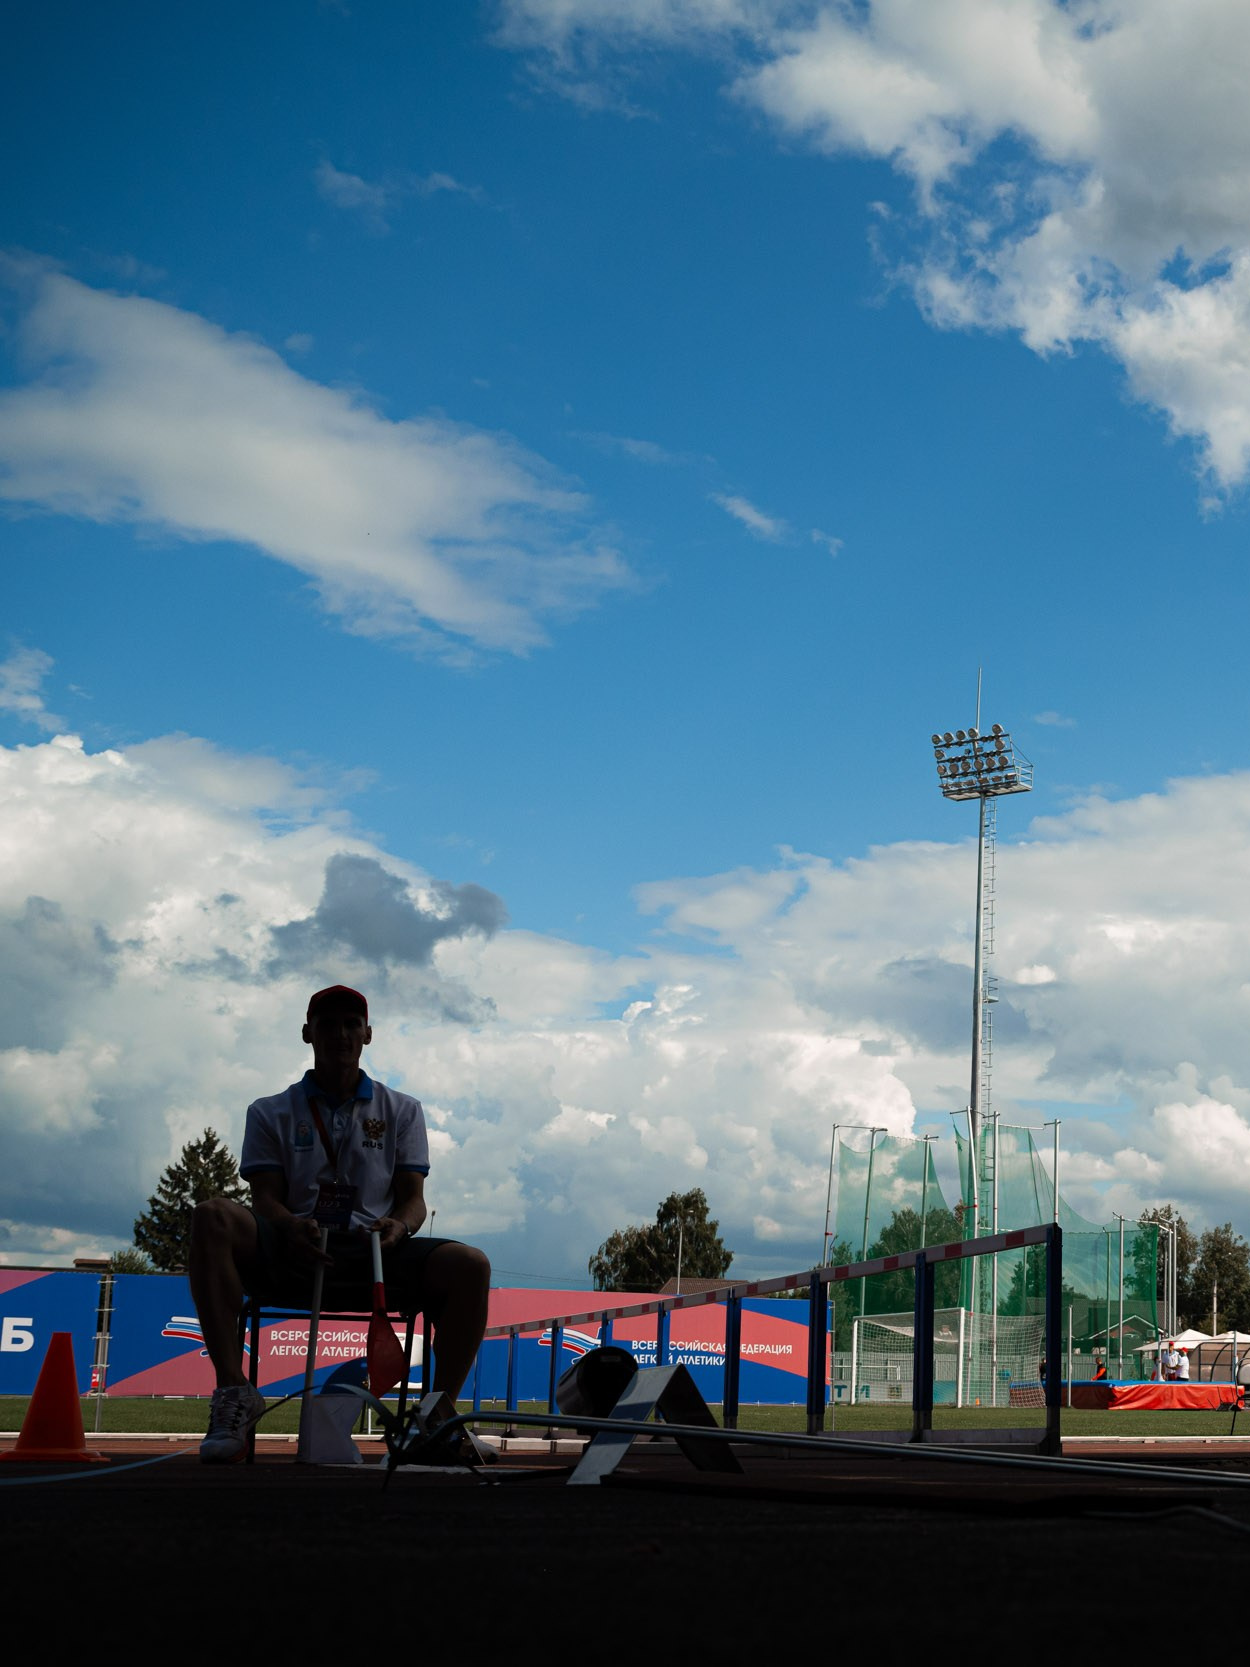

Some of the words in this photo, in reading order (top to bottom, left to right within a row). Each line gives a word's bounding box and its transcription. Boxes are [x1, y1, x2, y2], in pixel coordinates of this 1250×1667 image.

[362, 1140, 384, 1150] RUS
[0, 1316, 34, 1353] Б
[270, 1345, 318, 1356] ЛЕГКО
[631, 1339, 726, 1352] ВСЕРССИЙСКА
[741, 1343, 793, 1355] ЕДЕРАЦИЯ
[633, 1353, 673, 1364] ЛЕГКЙ
